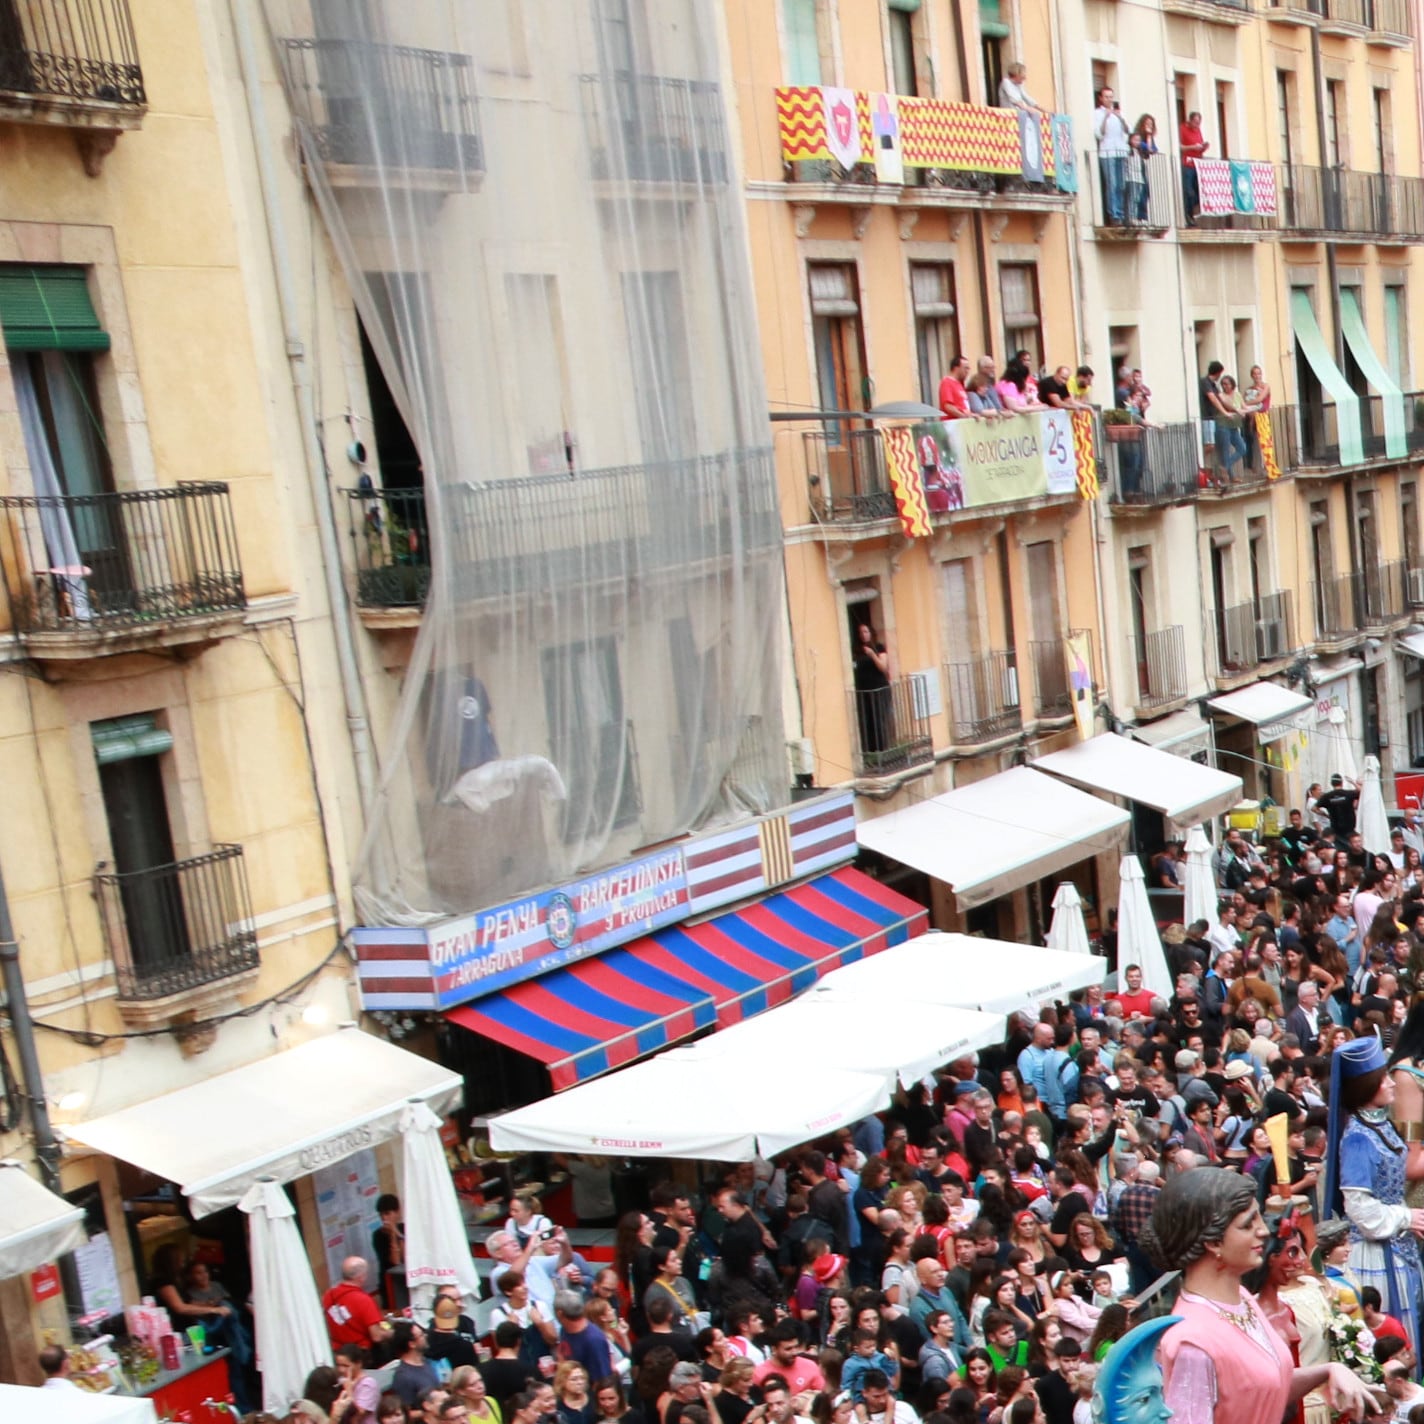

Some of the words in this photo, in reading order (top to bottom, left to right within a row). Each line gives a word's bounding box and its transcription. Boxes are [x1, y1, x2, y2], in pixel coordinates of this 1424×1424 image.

[431, 930, 477, 966] GRAN
[482, 901, 539, 948] PENYA
[580, 852, 683, 914] BARCELONISTA
[449, 947, 524, 989] TARRAGONA
[621, 889, 678, 925] PROVINCIA
[600, 1138, 636, 1148] ESTRELLA
[638, 1141, 662, 1150] DAMM
